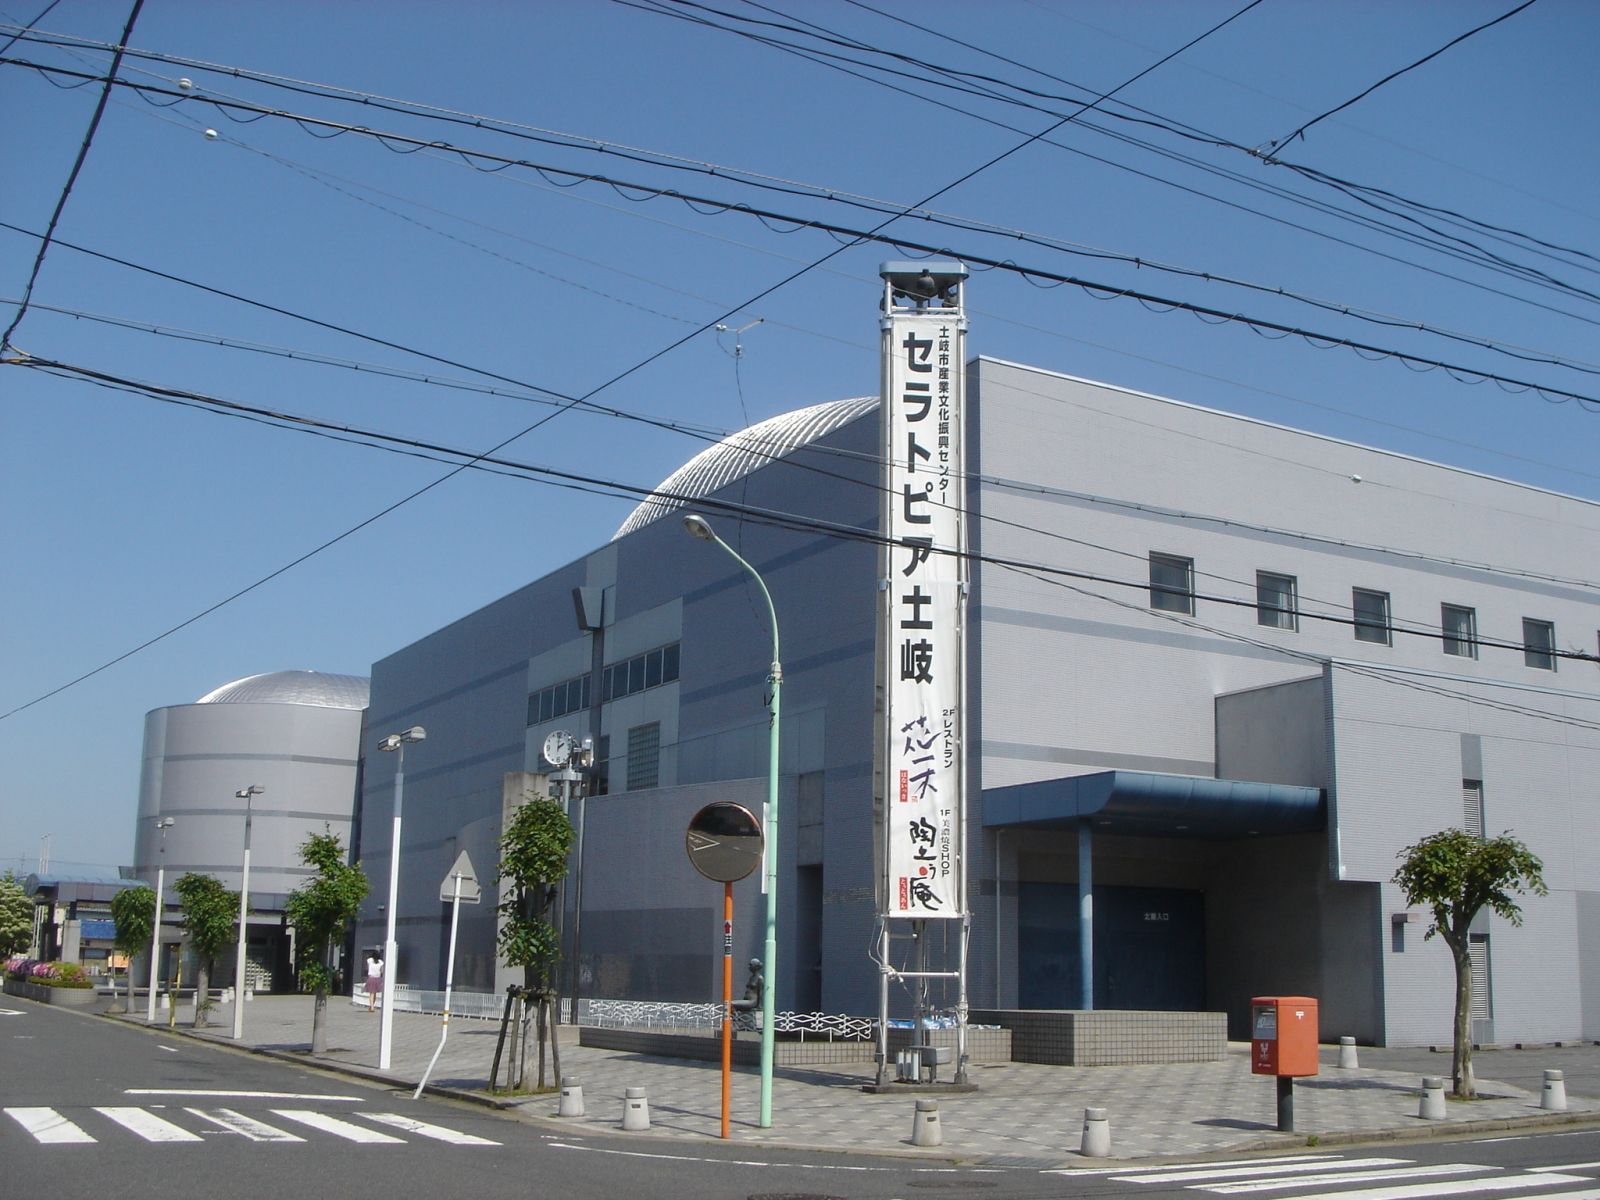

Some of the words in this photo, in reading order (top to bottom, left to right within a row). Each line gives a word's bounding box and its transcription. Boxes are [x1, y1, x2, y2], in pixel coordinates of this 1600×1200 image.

[938, 325, 950, 505] 土岐市産業文化振興センター
[900, 331, 934, 685] セラトピア土岐
[944, 720, 953, 768] レストラン
